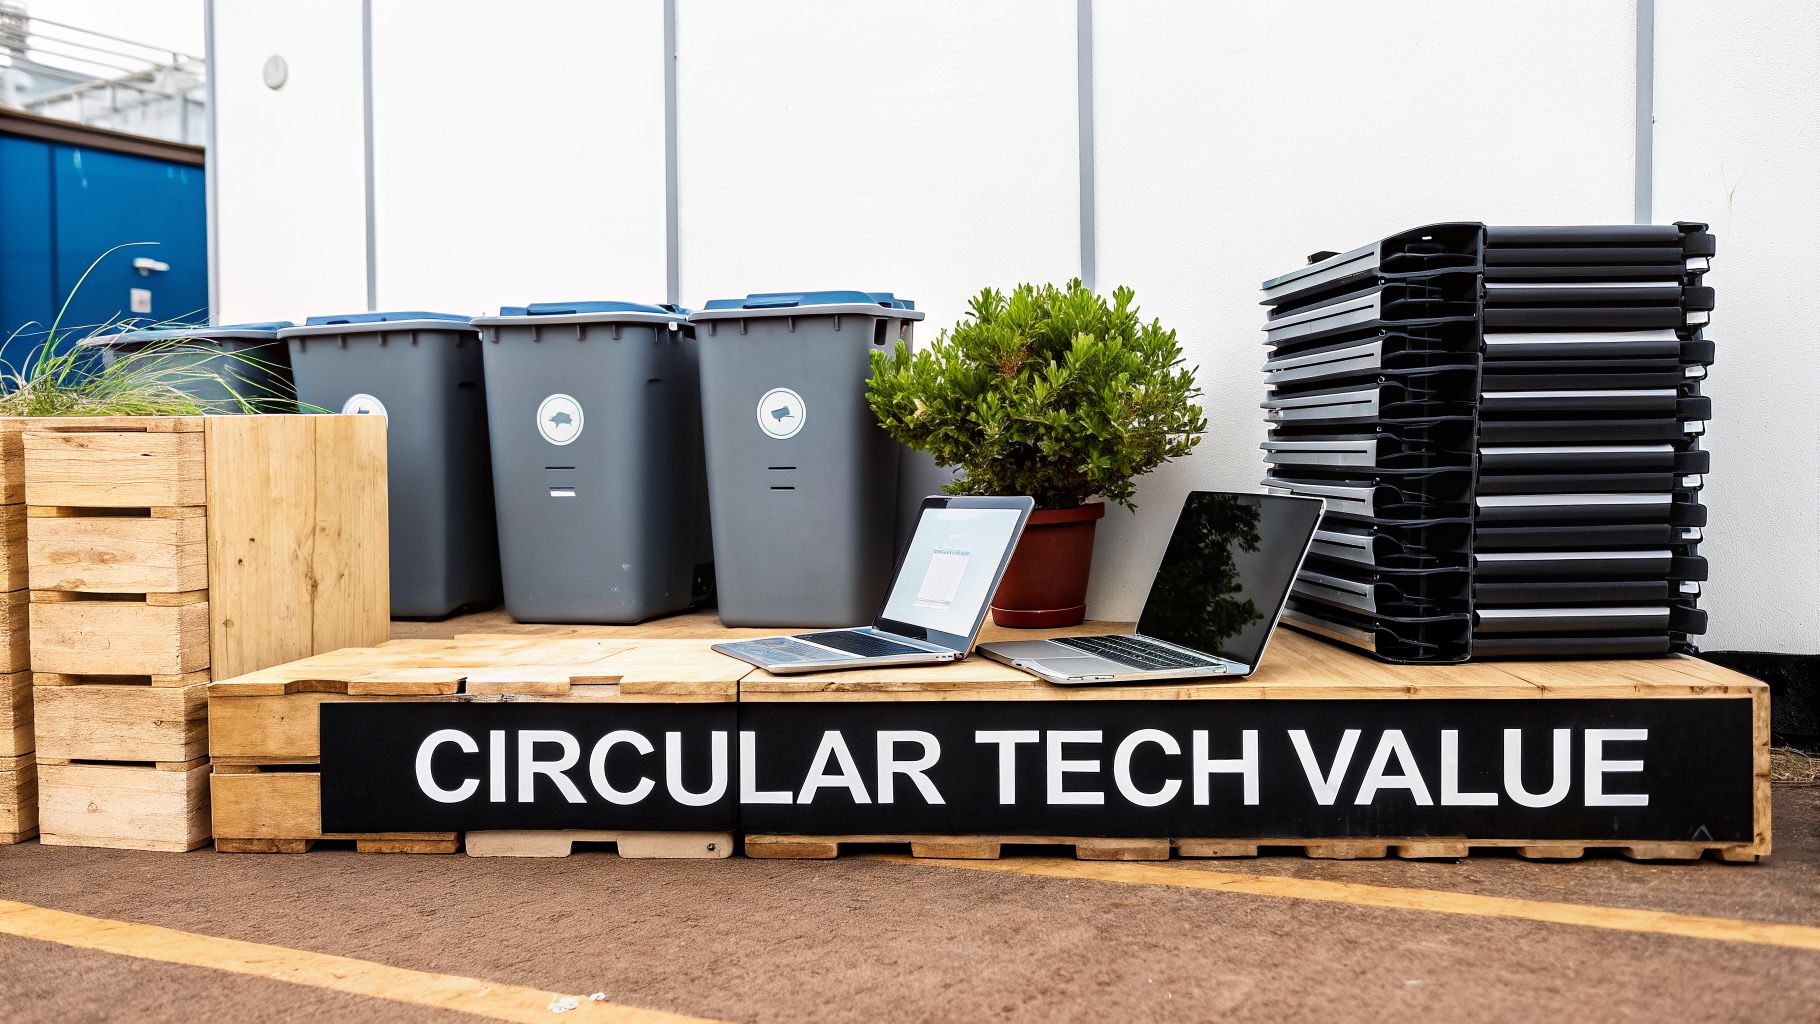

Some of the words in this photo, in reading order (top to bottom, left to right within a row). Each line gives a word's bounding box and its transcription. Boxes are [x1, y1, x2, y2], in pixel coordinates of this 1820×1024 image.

[415, 729, 946, 806] CIRCULAR
[975, 728, 1260, 807] TECH
[1287, 728, 1649, 808] VALUE
